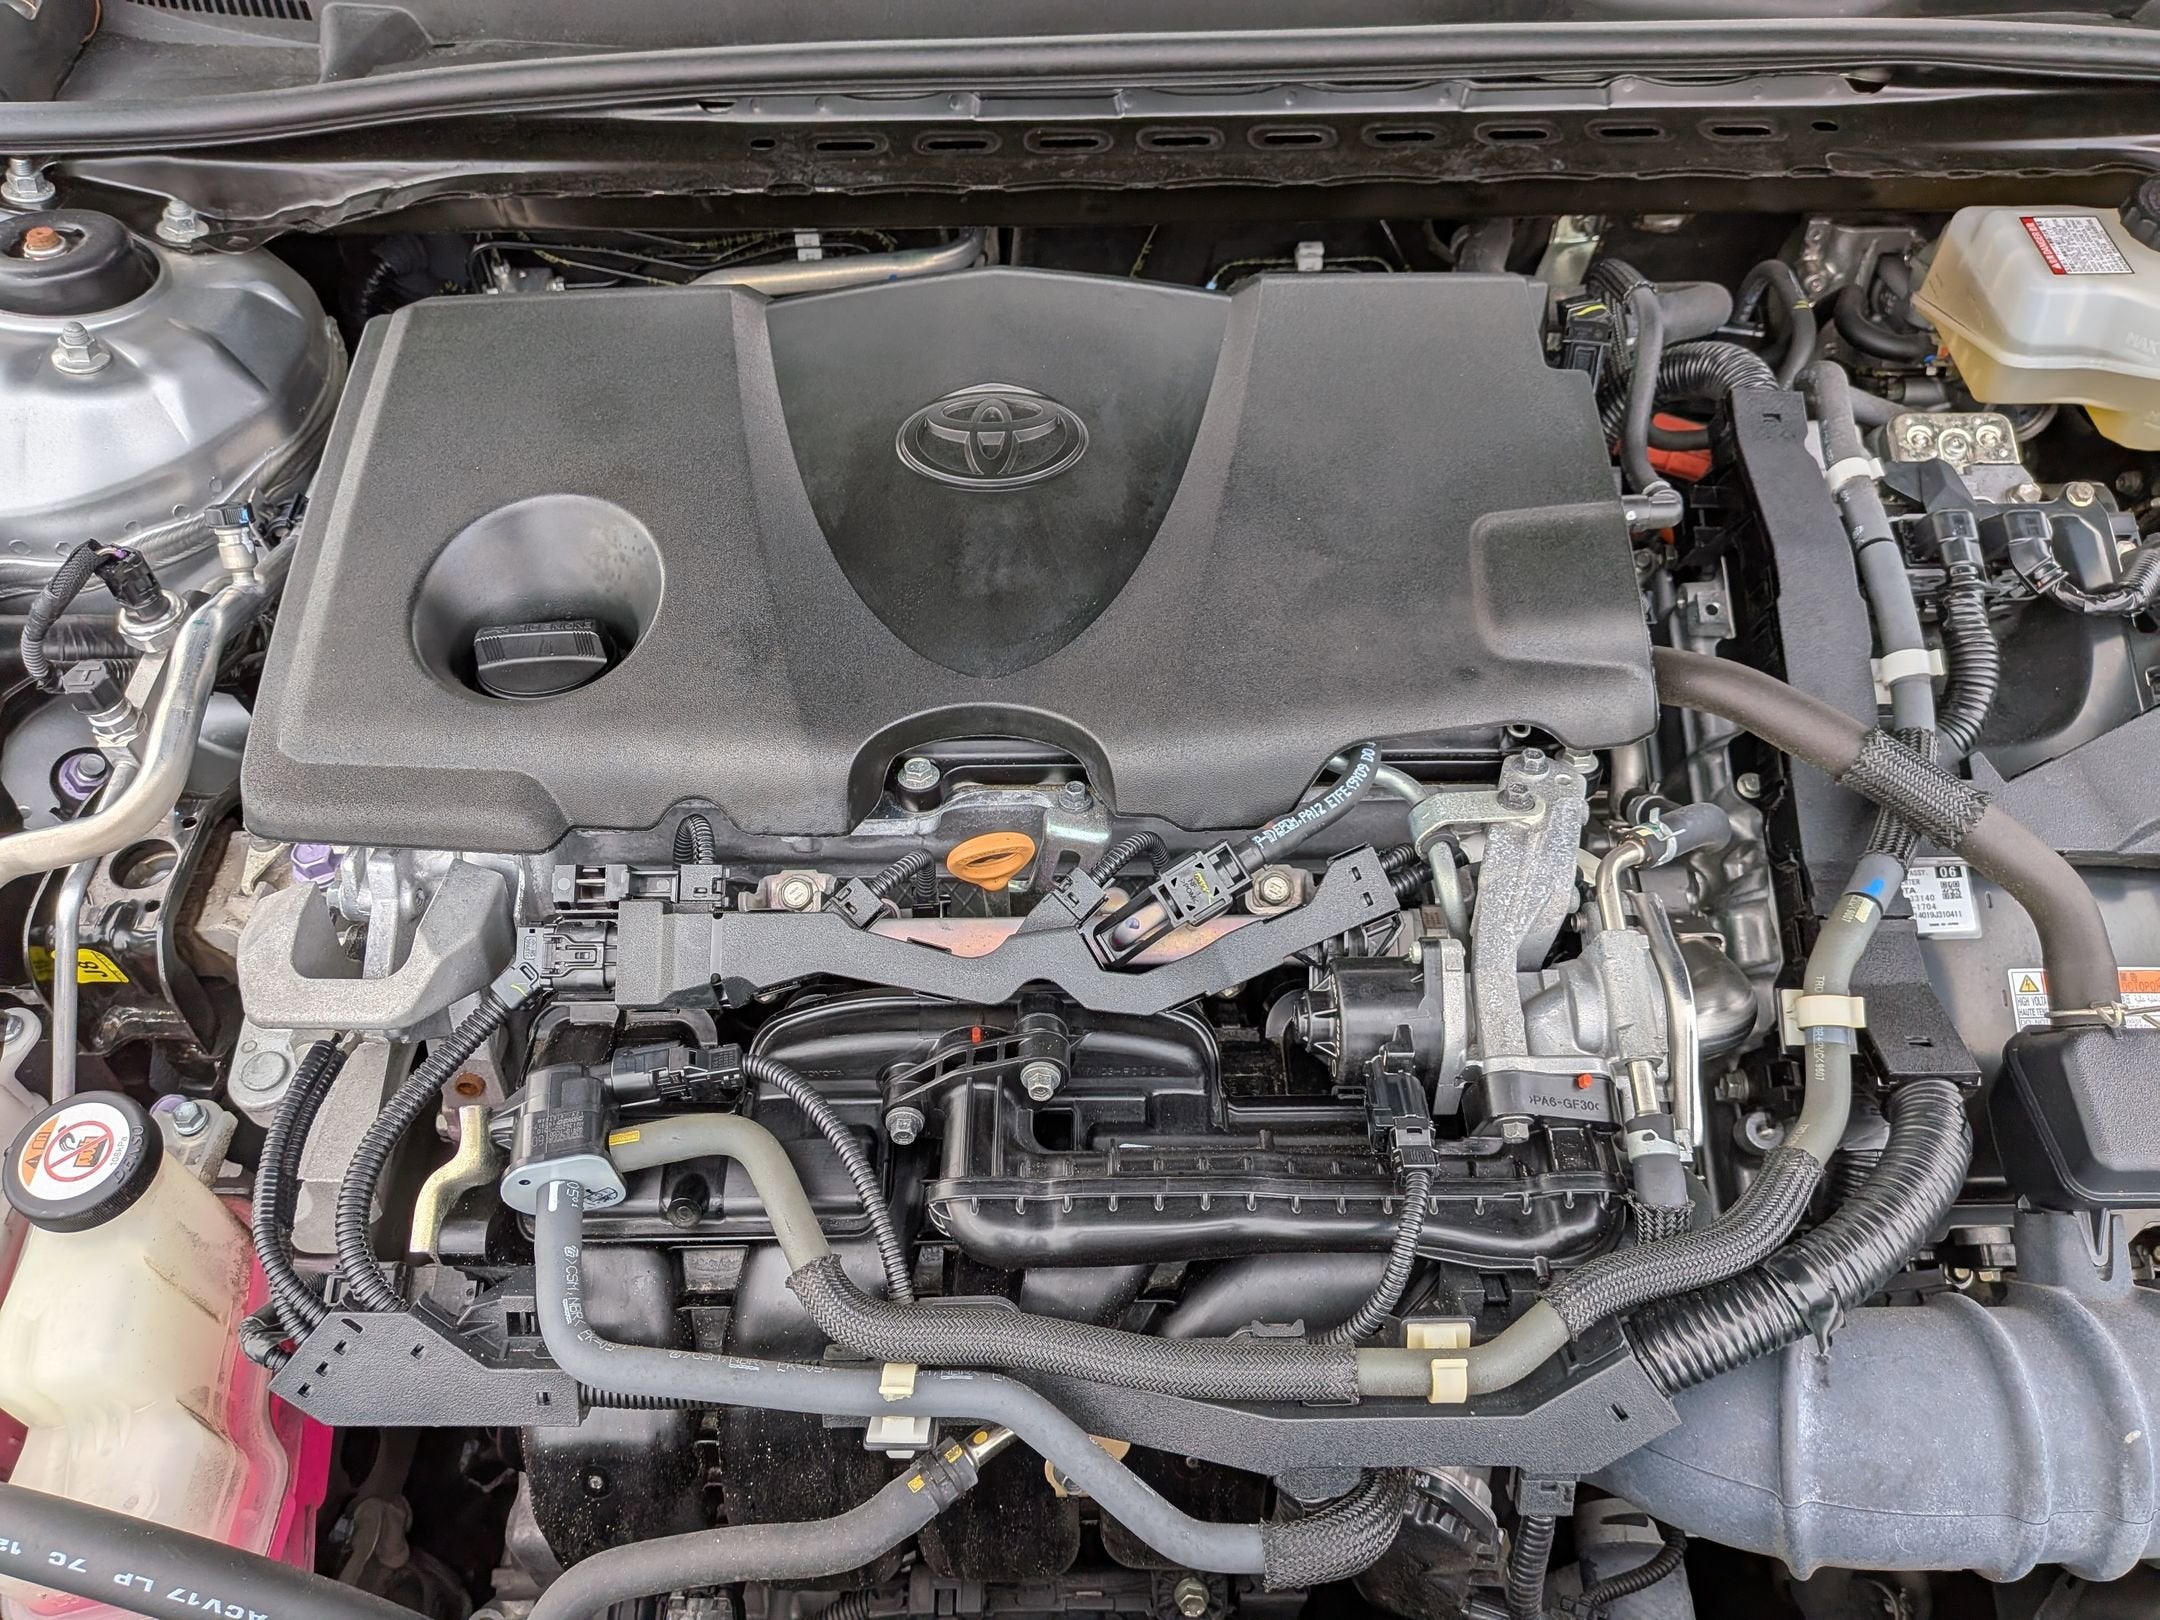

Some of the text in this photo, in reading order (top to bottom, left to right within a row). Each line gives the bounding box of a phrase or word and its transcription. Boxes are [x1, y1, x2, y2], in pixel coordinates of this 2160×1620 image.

[1939, 866, 1957, 878] 06
[110, 1135, 128, 1167] 108kPa
[113, 1124, 145, 1185] DENSO
[48, 1551, 88, 1573] 7C
[113, 1572, 156, 1592] LP
[166, 1587, 269, 1620] ACV17
